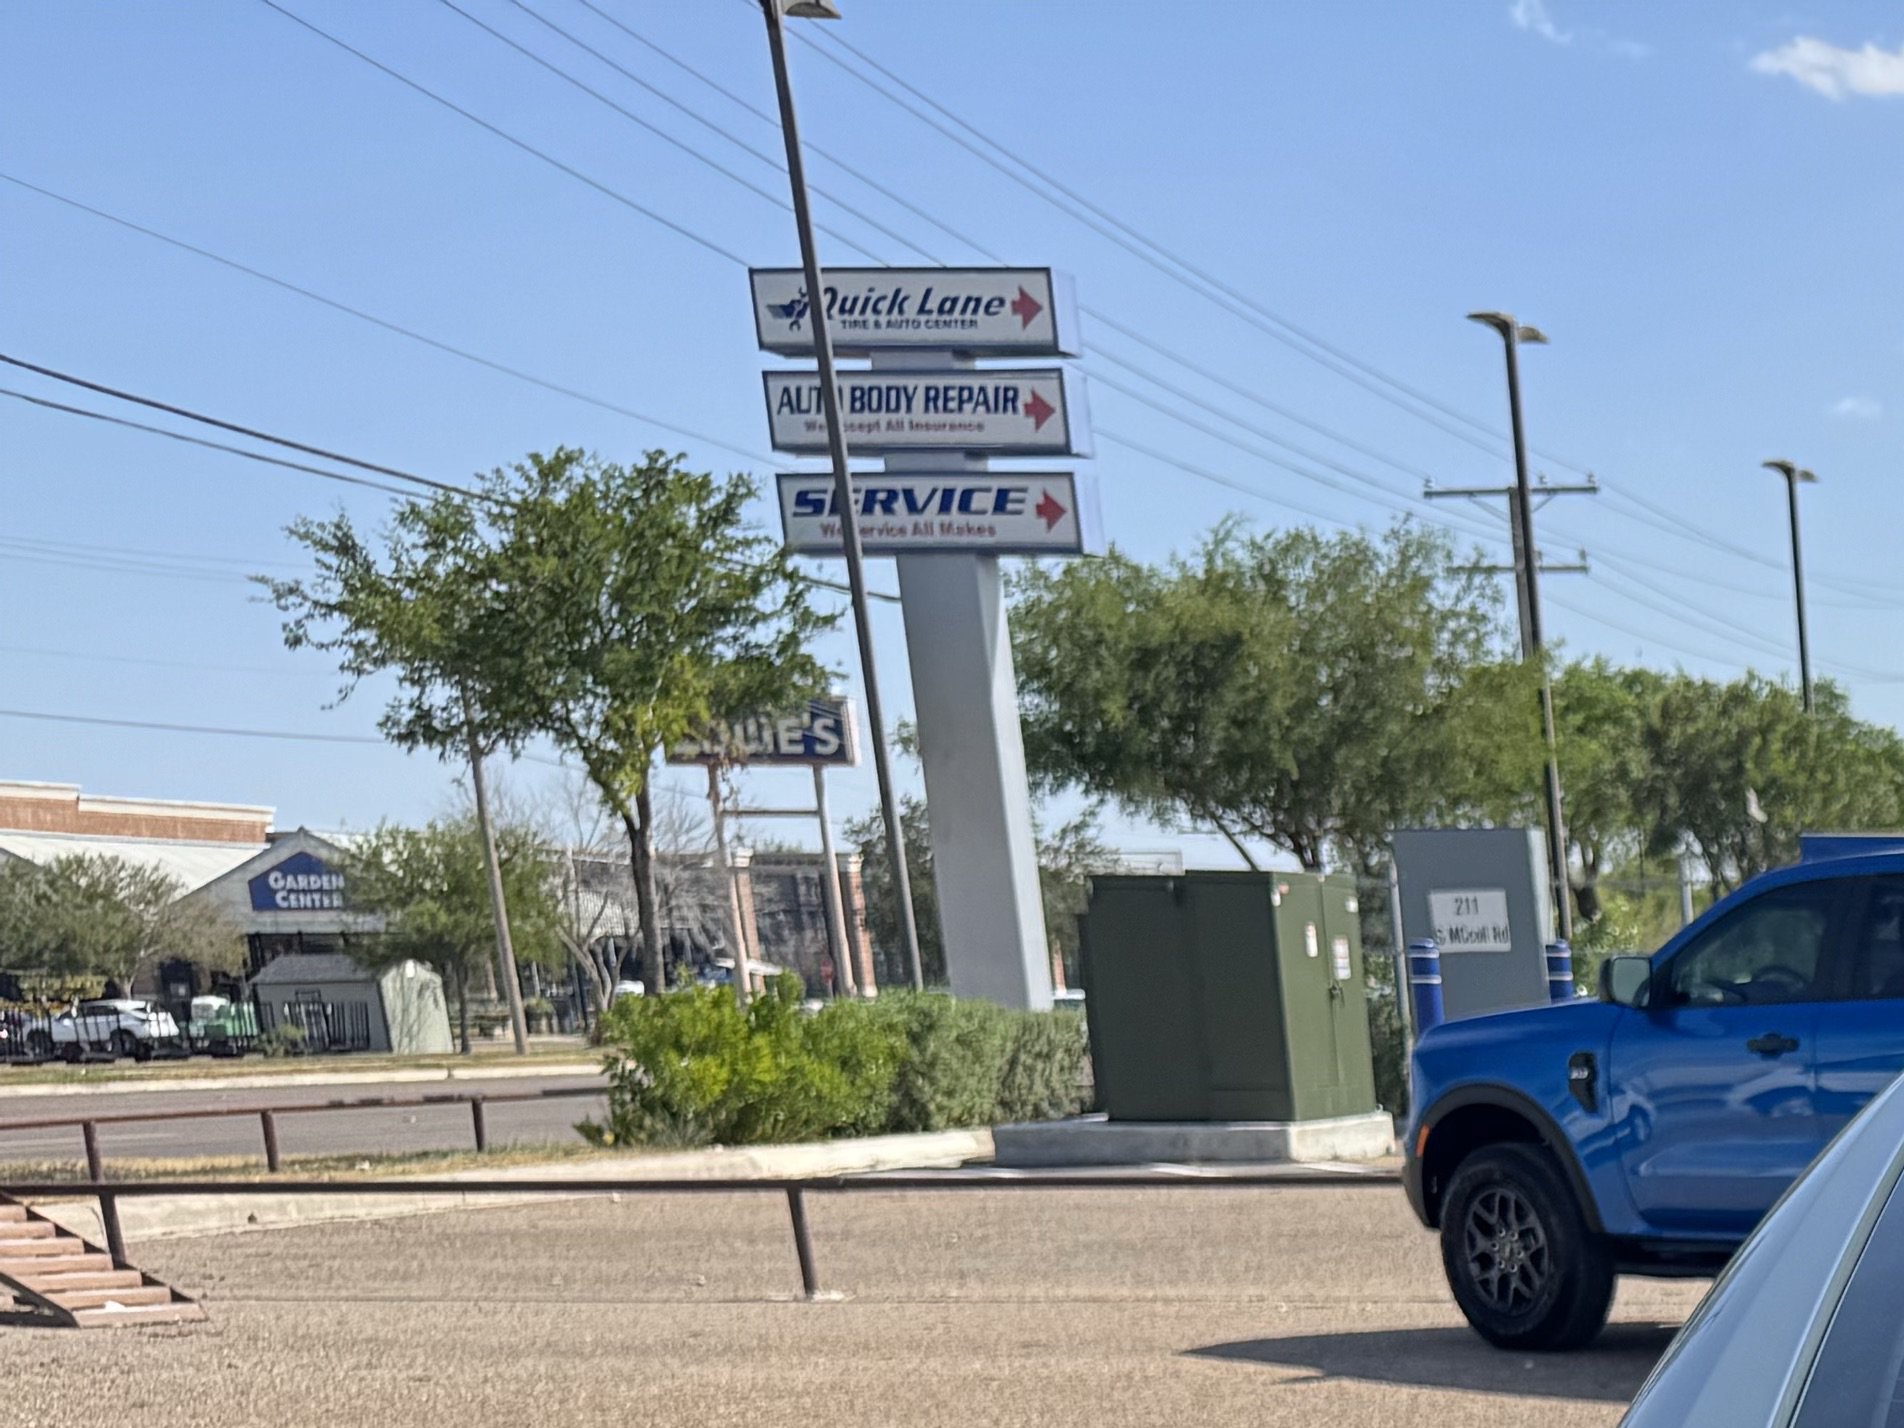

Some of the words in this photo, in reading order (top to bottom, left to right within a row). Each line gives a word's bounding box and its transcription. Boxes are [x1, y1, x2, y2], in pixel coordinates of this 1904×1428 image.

[916, 286, 1005, 316] Lane
[840, 319, 869, 330] TIRE
[885, 319, 921, 330] AUTO
[924, 319, 978, 330] CENTER
[777, 385, 843, 415] AUT
[850, 385, 918, 415] BODY
[923, 385, 1020, 415] REPAIR
[885, 420, 904, 432] All
[909, 420, 985, 432] Insurance
[858, 521, 907, 537] ervice
[911, 520, 934, 537] All
[940, 520, 997, 537] Makes
[268, 871, 345, 890] GARDEN
[275, 890, 344, 909] CENTER
[1454, 896, 1479, 916] 211
